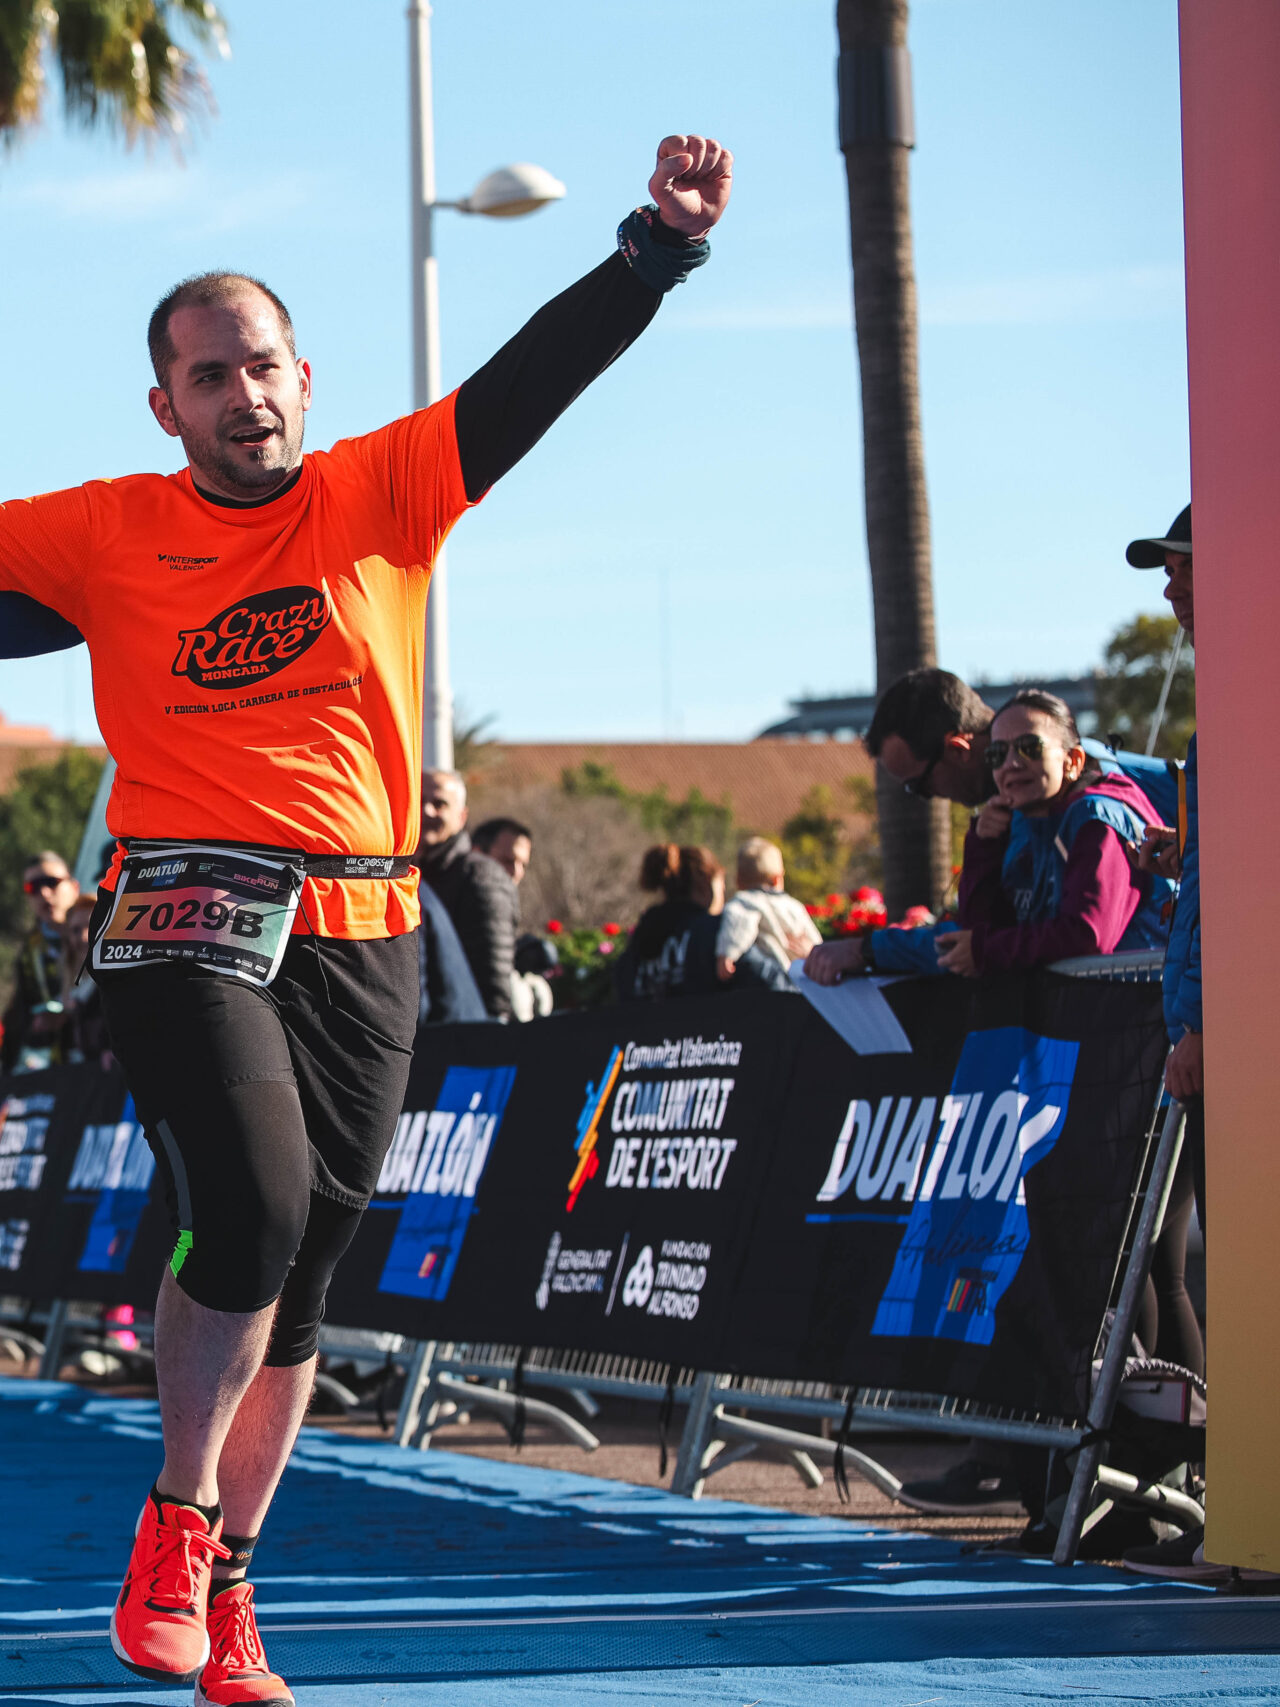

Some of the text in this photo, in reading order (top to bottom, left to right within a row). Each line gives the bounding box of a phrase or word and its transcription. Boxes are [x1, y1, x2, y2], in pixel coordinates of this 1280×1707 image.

[167, 555, 219, 564] INTERSPORT
[218, 596, 331, 638] Crazy
[175, 627, 304, 673] Race
[202, 664, 270, 681] MONCADA
[164, 675, 363, 715] V EDICIÓN LOCA CARRERA DE OBSTÁCULOS
[137, 860, 189, 879] DUATLÓN
[125, 899, 264, 939] 7029B
[104, 945, 143, 960] 2024
[611, 1077, 735, 1133] COMUNITAT
[375, 1092, 497, 1197] UATLÓN
[605, 1137, 642, 1188] DE
